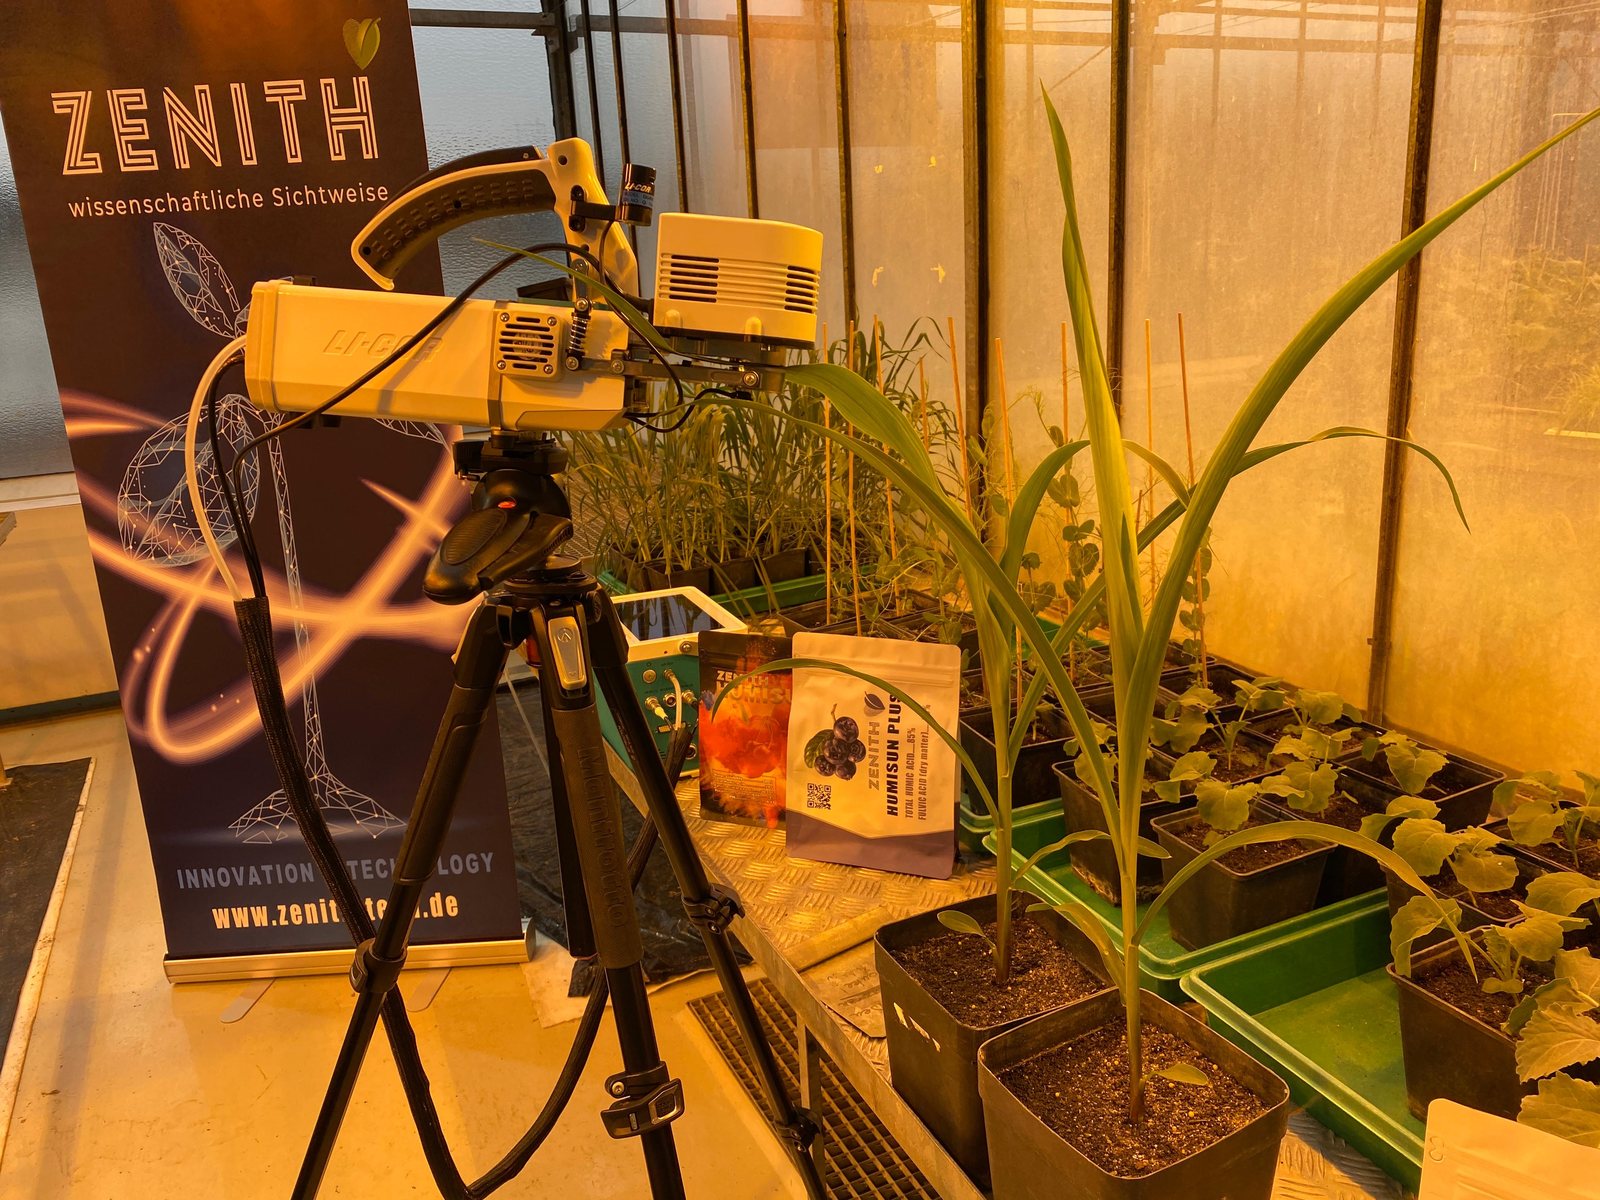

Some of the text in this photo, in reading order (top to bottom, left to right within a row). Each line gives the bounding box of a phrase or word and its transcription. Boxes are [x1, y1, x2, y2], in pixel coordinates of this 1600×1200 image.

[51, 76, 379, 175] ZENITH
[68, 182, 389, 218] wissenschaftliche Sichtweise
[868, 721, 880, 791] ZENITH
[886, 694, 902, 817] HUMISUN PLUS
[905, 772, 915, 796] HUMIC
[918, 778, 927, 796] ACID
[905, 799, 914, 819] TOTAL
[918, 796, 927, 820] FULVIC
[176, 851, 495, 889] INNOVATION TECLOGY
[211, 891, 459, 930] www.zenitte.de
